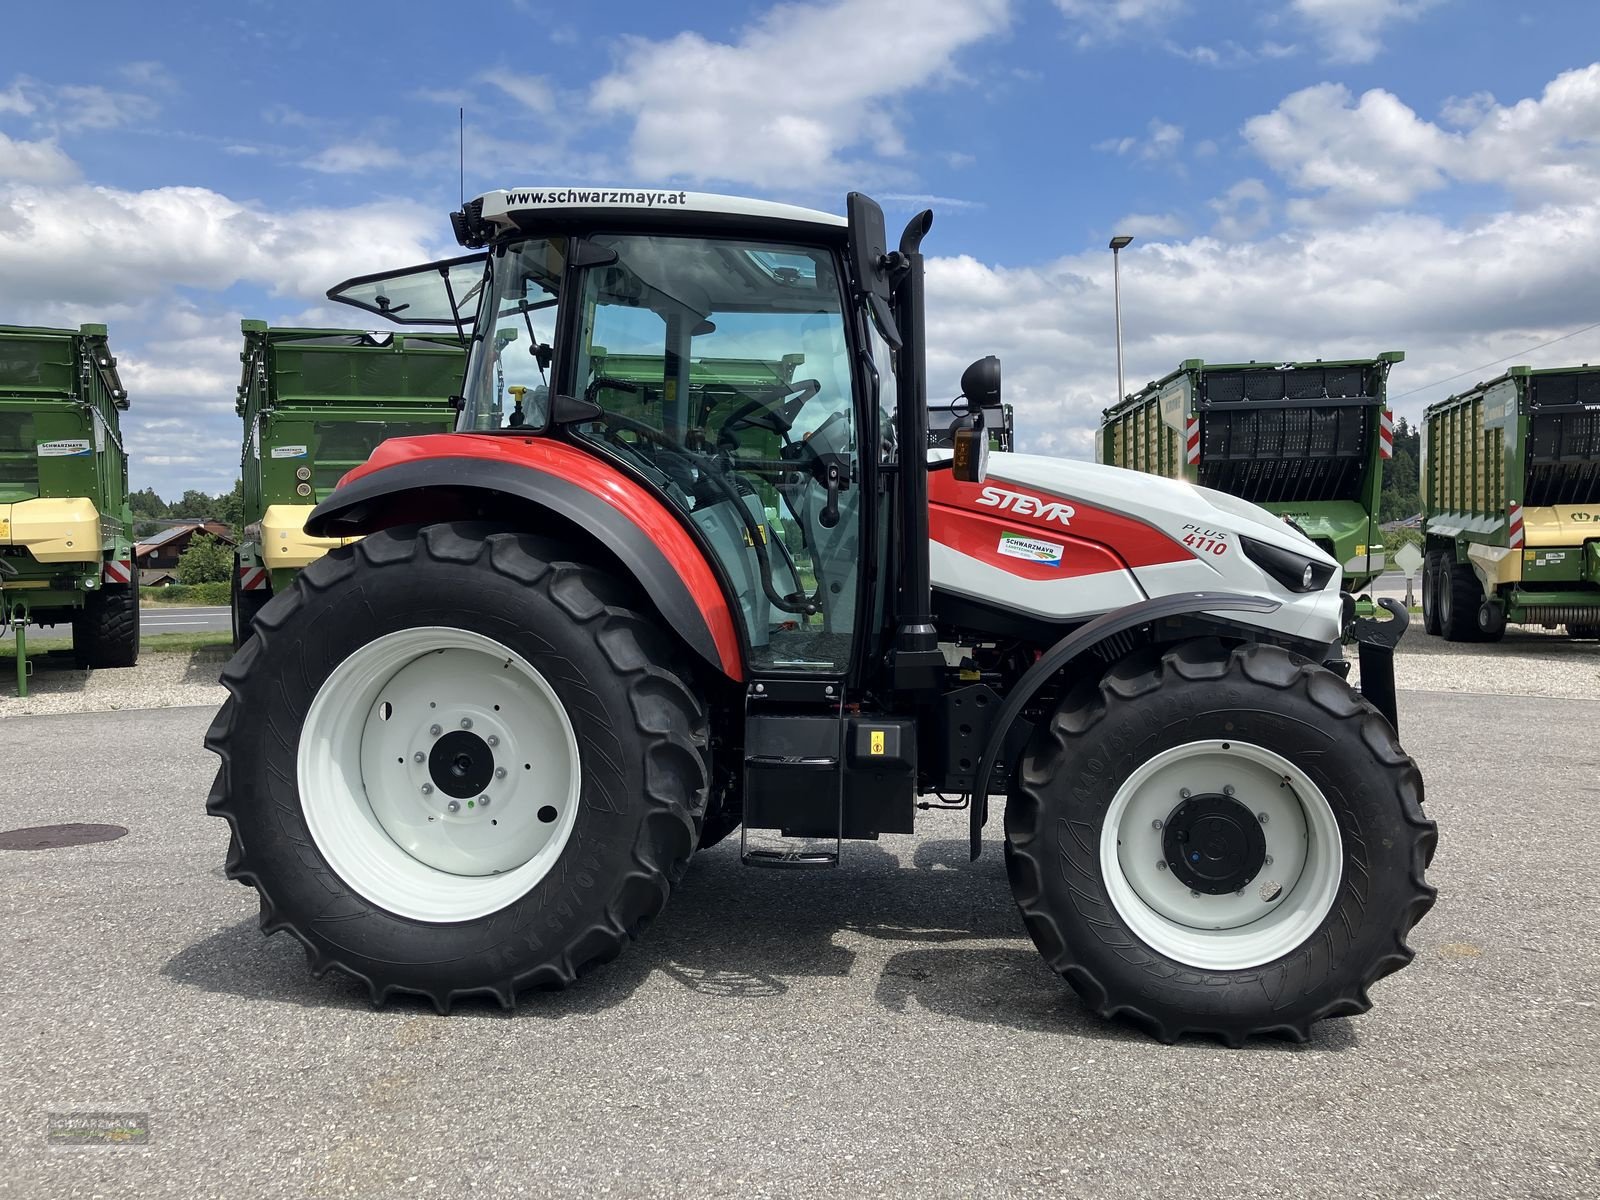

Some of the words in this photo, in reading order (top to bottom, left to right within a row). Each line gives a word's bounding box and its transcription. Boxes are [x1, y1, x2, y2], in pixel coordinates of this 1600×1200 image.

[506, 189, 686, 206] www.schwarzmayr.at
[975, 486, 1076, 526] STEYR
[1182, 524, 1228, 540] PLUS
[1005, 538, 1054, 554] SCHWARZMAYR
[1182, 533, 1228, 556] 4110
